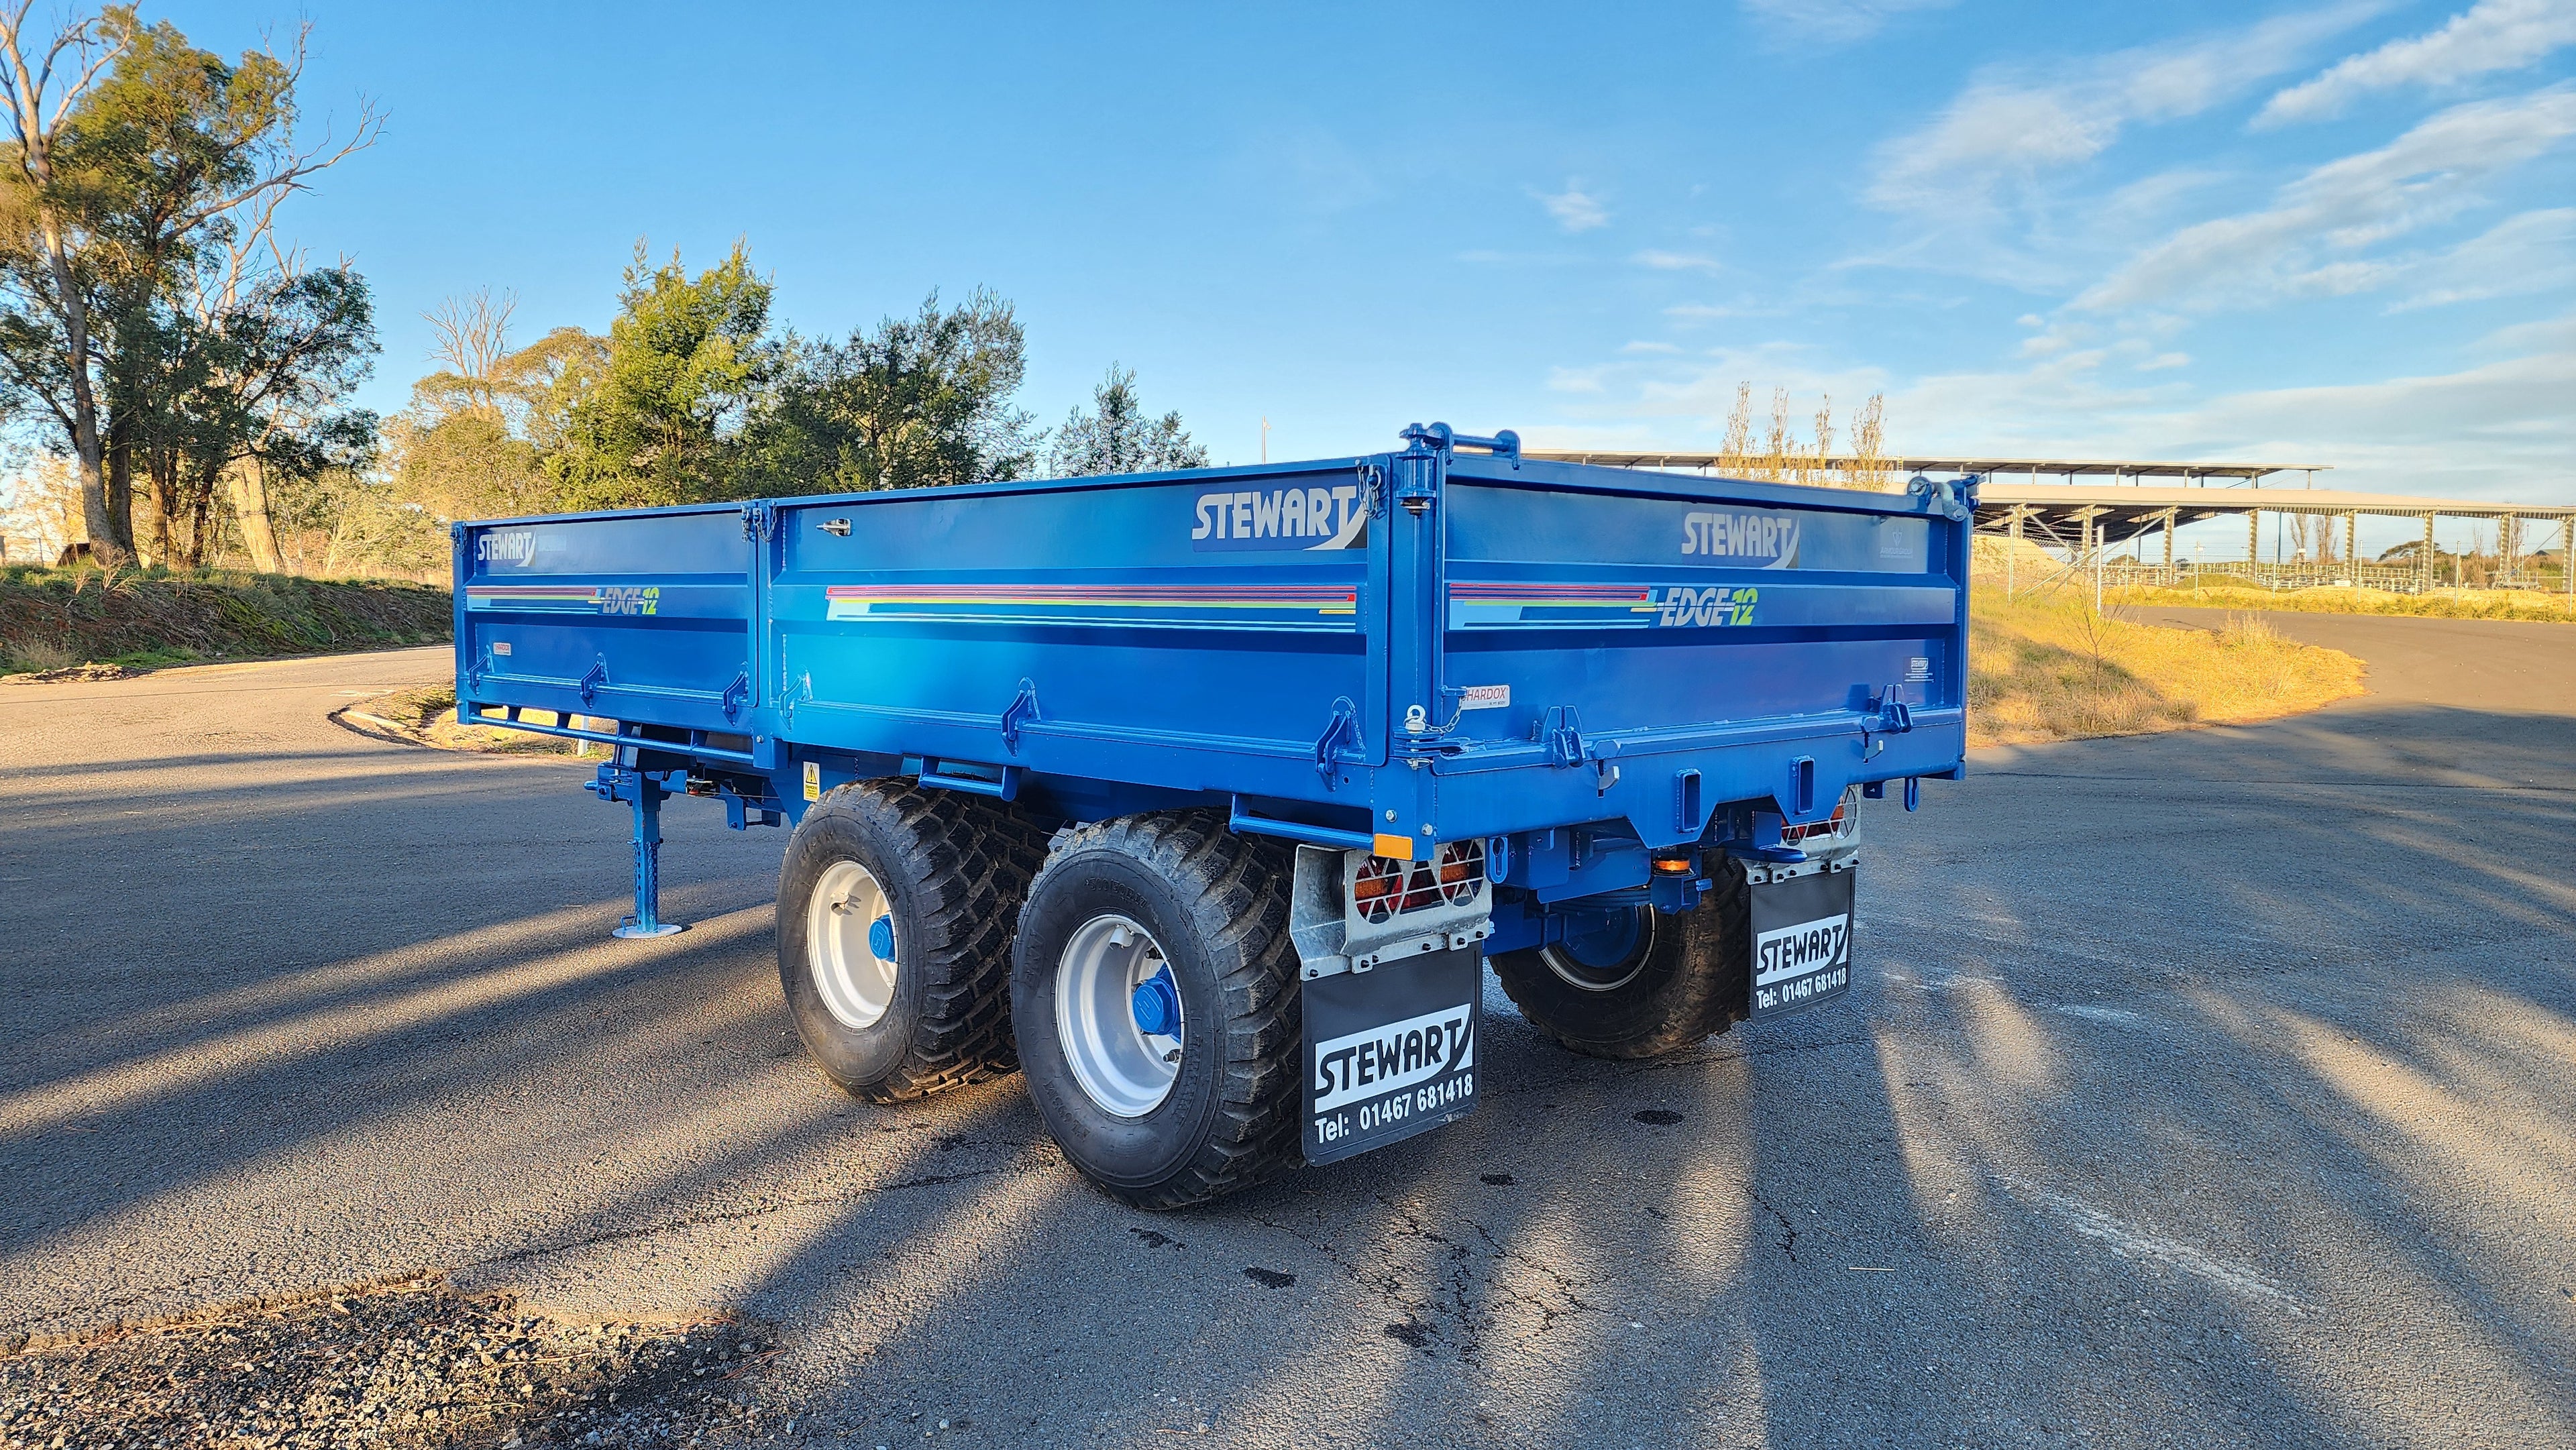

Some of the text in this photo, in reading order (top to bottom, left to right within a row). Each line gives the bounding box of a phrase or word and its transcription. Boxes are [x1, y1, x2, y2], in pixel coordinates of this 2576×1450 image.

[1191, 486, 1367, 551] STEWART
[1681, 512, 1800, 569] STEWART
[478, 531, 536, 567] STEWART
[602, 588, 641, 615] EDGE
[1660, 588, 1731, 626] EDGE
[1466, 687, 1507, 701] HARDOX
[1757, 922, 1848, 975] STEWART
[1756, 967, 1847, 1009] Tel: 01467 681418
[1314, 1013, 1472, 1099] STEWART
[1315, 1074, 1473, 1144] Tel: 01467 681418
